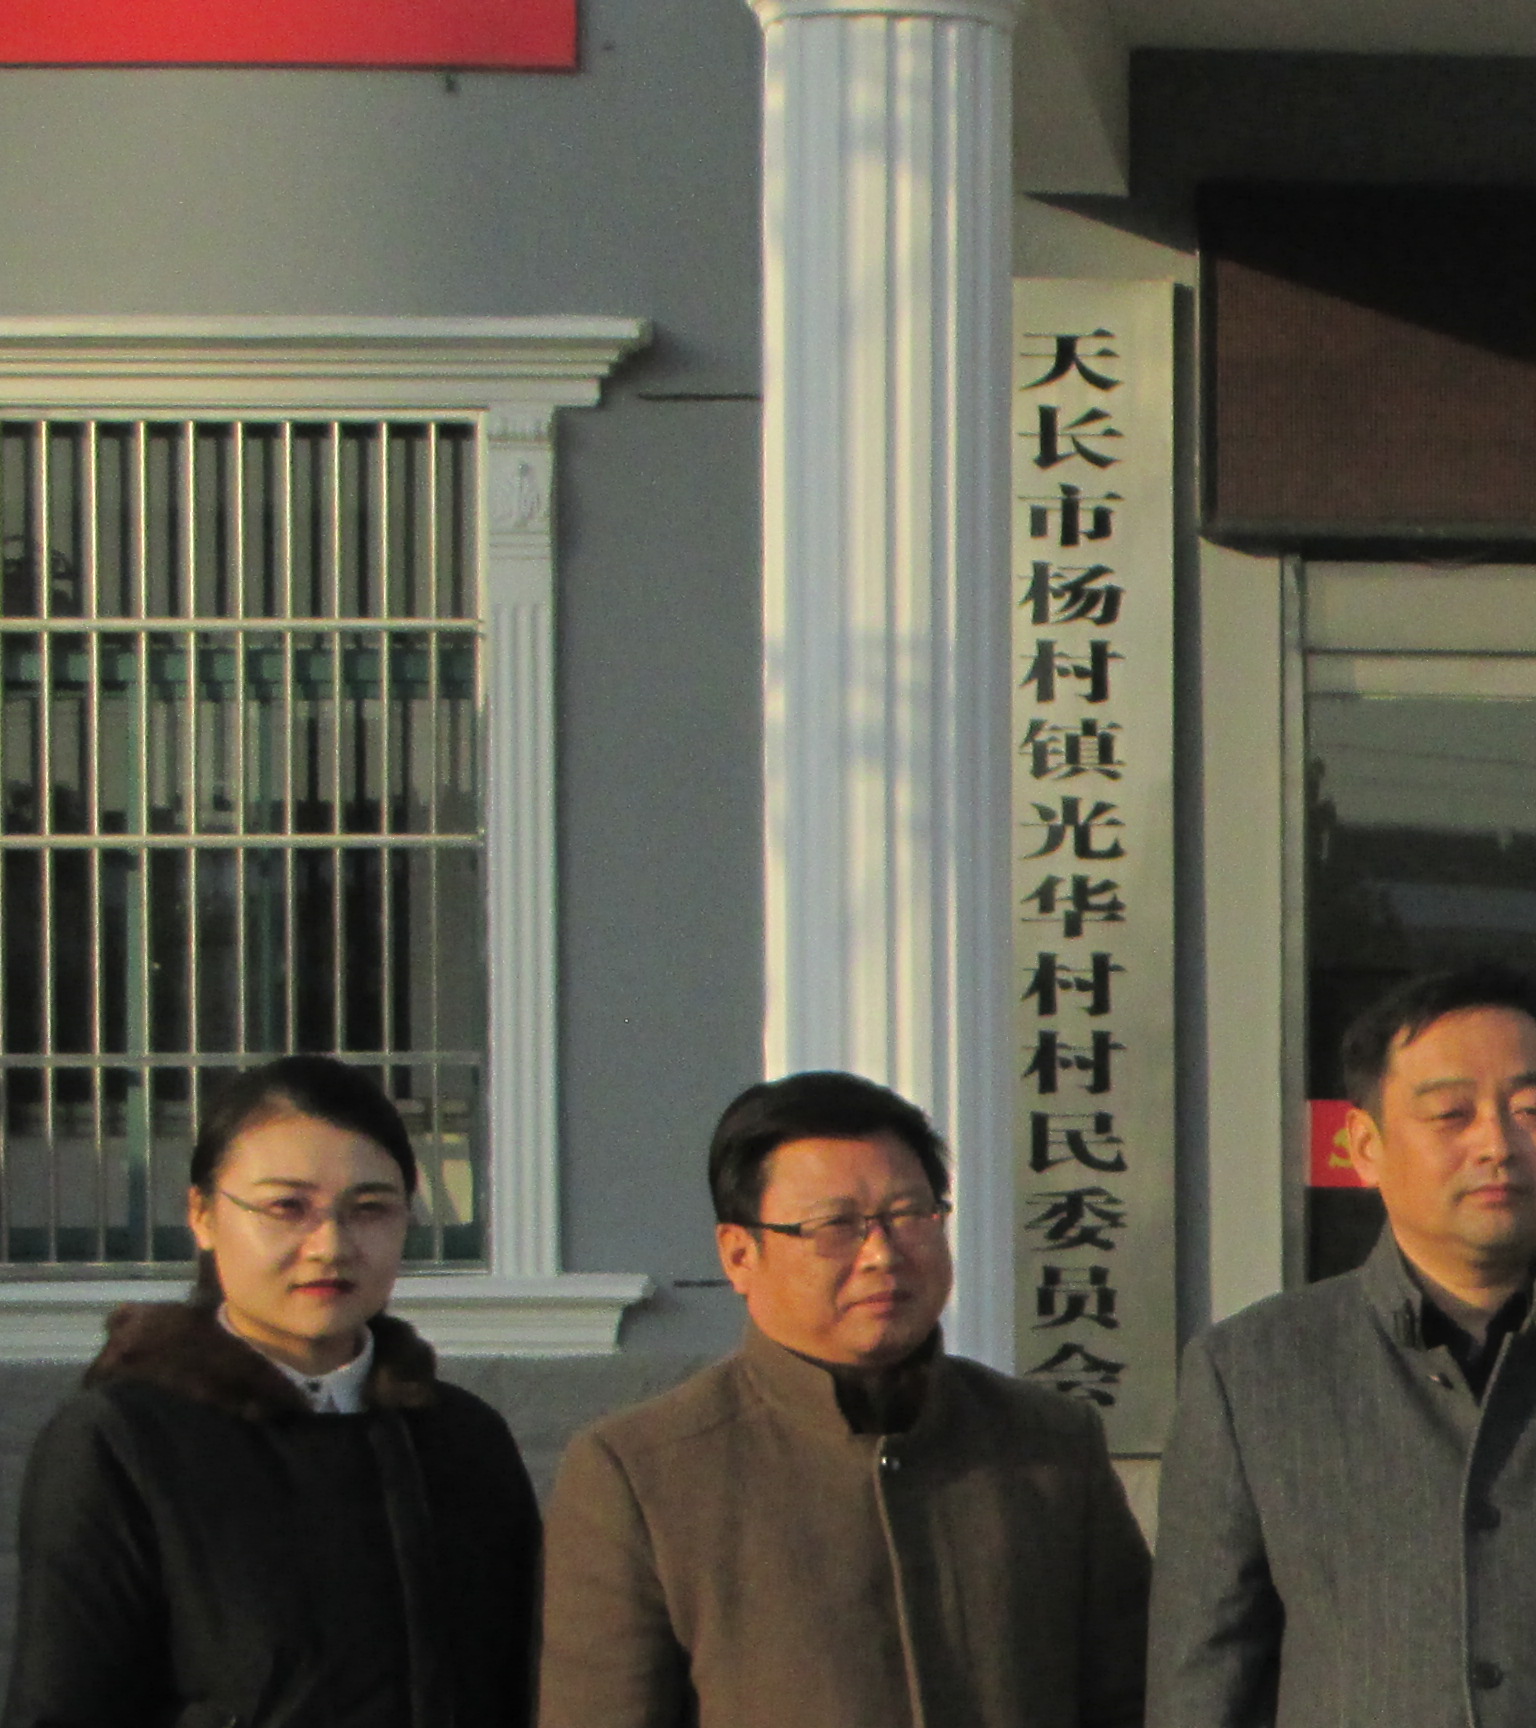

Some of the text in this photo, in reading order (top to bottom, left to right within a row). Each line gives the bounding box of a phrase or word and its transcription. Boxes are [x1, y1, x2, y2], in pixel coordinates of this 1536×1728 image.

[1018, 327, 1128, 1407] 天长市杨村镇光华村村民委员会
